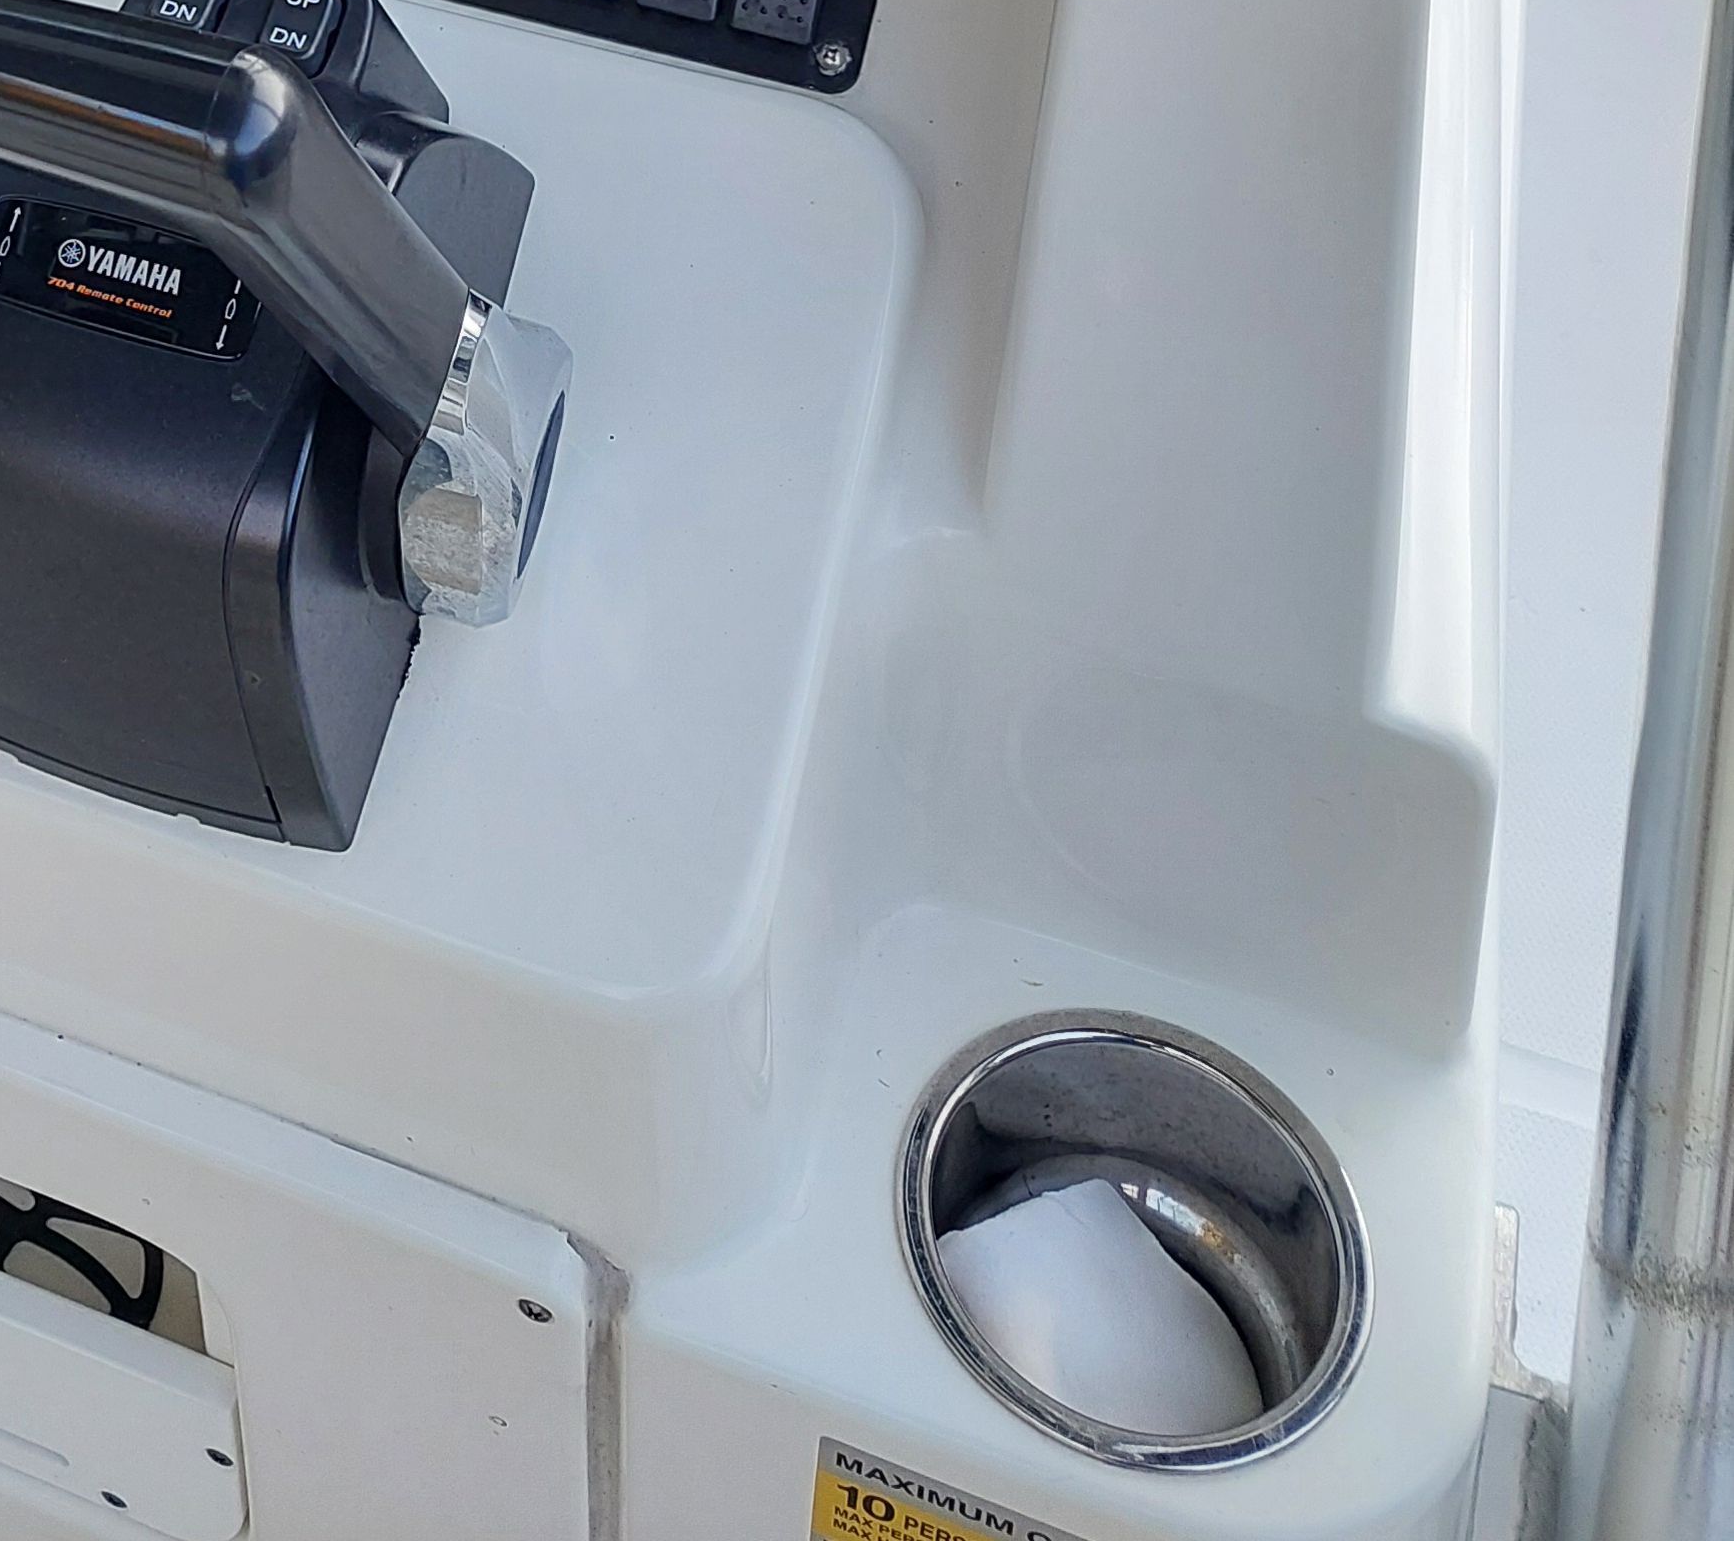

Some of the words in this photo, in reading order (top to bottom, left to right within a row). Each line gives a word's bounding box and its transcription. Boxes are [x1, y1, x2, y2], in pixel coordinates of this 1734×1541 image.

[159, 0, 198, 22] DN
[269, 27, 308, 50] DN
[87, 245, 182, 296] YAMAHA
[76, 285, 124, 305] Remote
[126, 298, 173, 318] Control
[835, 1452, 1015, 1536] MAXIMUM
[837, 1483, 896, 1522] 10
[832, 1518, 871, 1541] MAX
[834, 1506, 874, 1529] MAX
